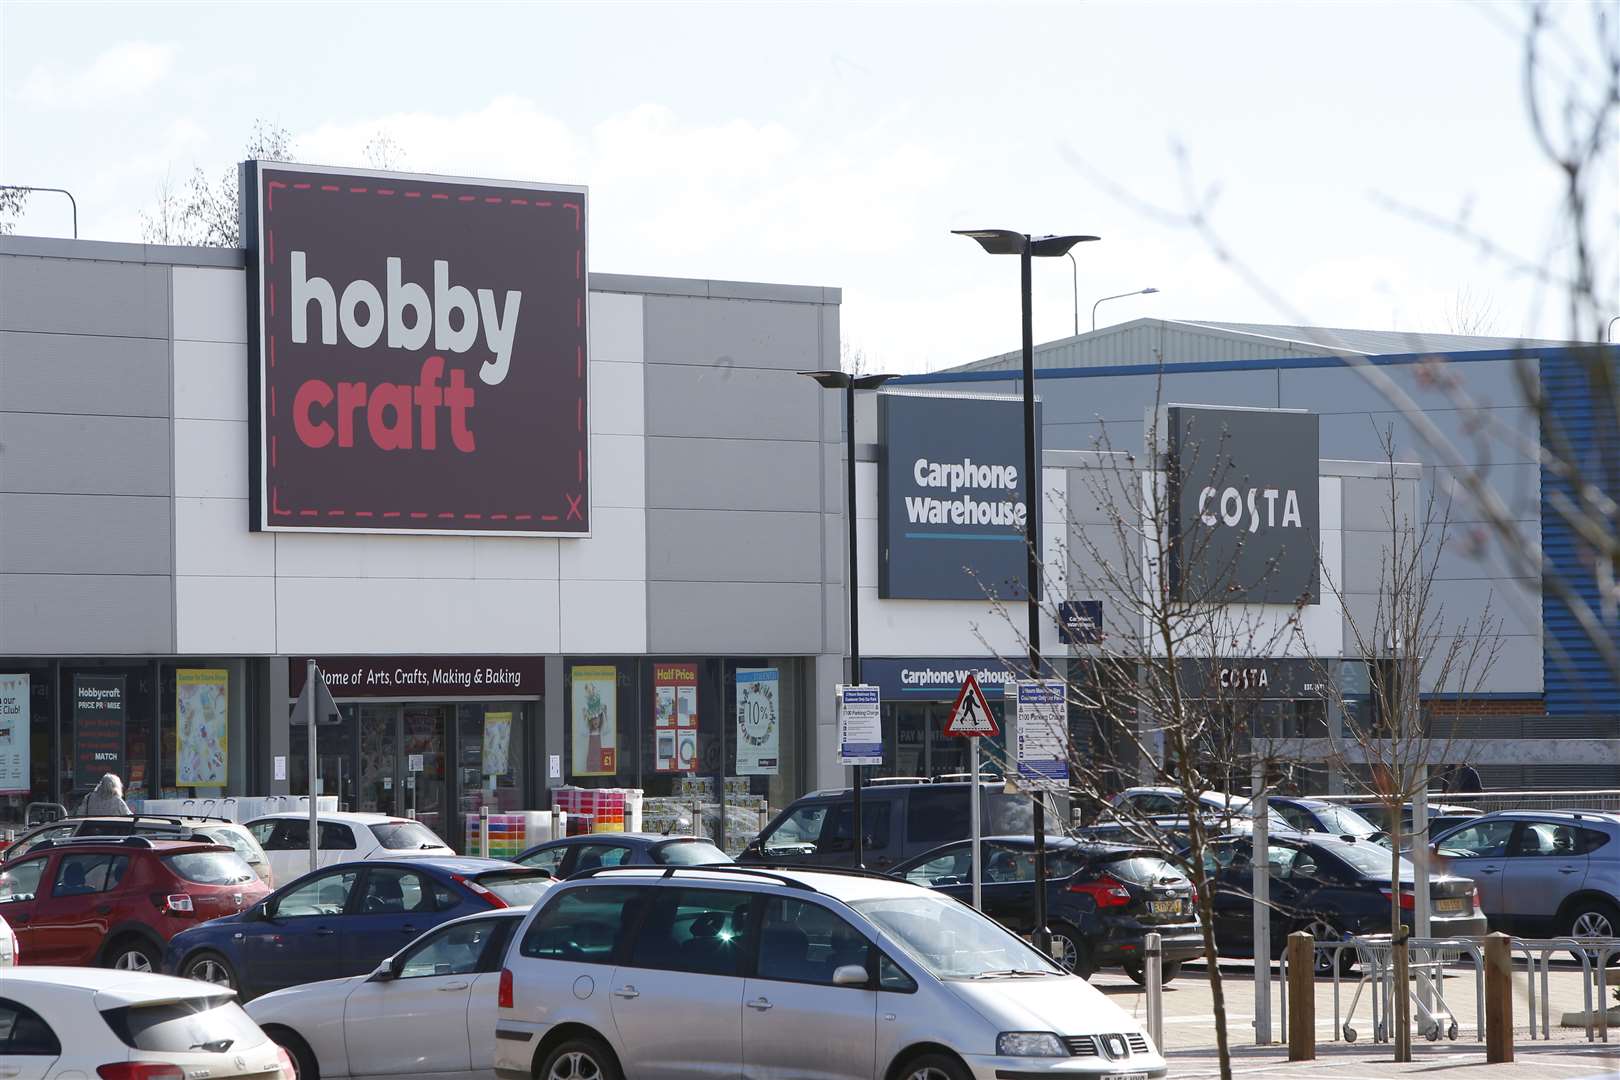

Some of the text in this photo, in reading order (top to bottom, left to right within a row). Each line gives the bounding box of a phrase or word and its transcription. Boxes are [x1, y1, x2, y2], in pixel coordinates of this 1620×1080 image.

[291, 251, 522, 385] hobby
[293, 356, 476, 452] craft
[914, 458, 1017, 492] Carphone
[905, 495, 1026, 526] Warehouse
[1199, 486, 1302, 533] COSTA
[351, 669, 363, 685] of
[366, 669, 392, 686] Arts,
[394, 668, 430, 686] Crafts,
[432, 668, 472, 688] Making
[473, 669, 483, 684] &
[485, 668, 521, 688] Baking
[657, 668, 695, 681] Half Price
[901, 668, 954, 686] Carphone
[1220, 668, 1268, 689] COSTA
[3, 697, 16, 705] our
[78, 688, 120, 700] Hobbycraft
[78, 701, 120, 710] PRICE PRMISE
[748, 701, 768, 725] 10%
[94, 752, 118, 760] MATCH
